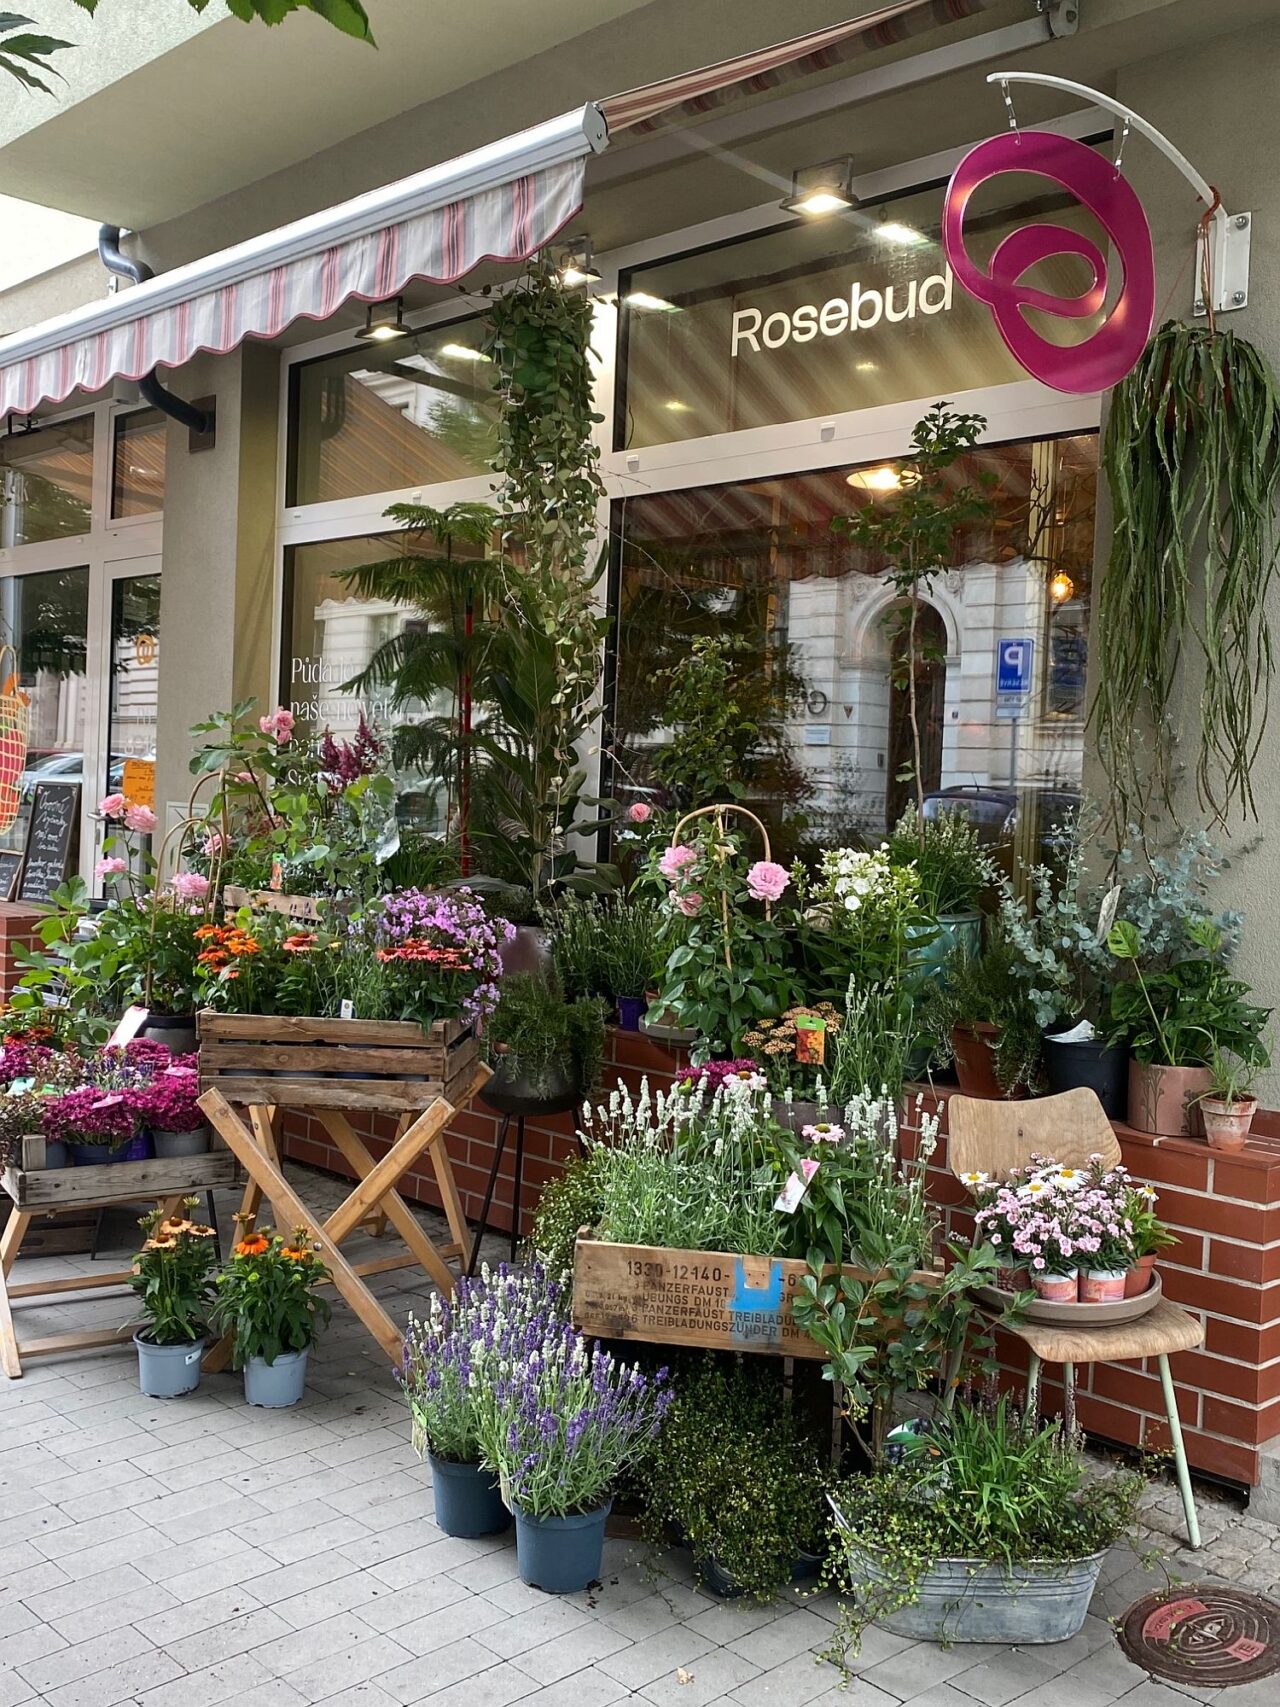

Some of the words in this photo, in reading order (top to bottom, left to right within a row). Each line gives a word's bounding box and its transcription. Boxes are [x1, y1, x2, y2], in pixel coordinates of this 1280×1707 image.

[731, 265, 953, 357] Rosebud
[291, 657, 332, 683] Půda
[291, 694, 329, 720] naše
[643, 1280, 729, 1298] PANZERFAUST
[642, 1303, 725, 1320] PANZERFAUST
[694, 1297, 712, 1308] DM
[782, 1327, 800, 1339] DM
